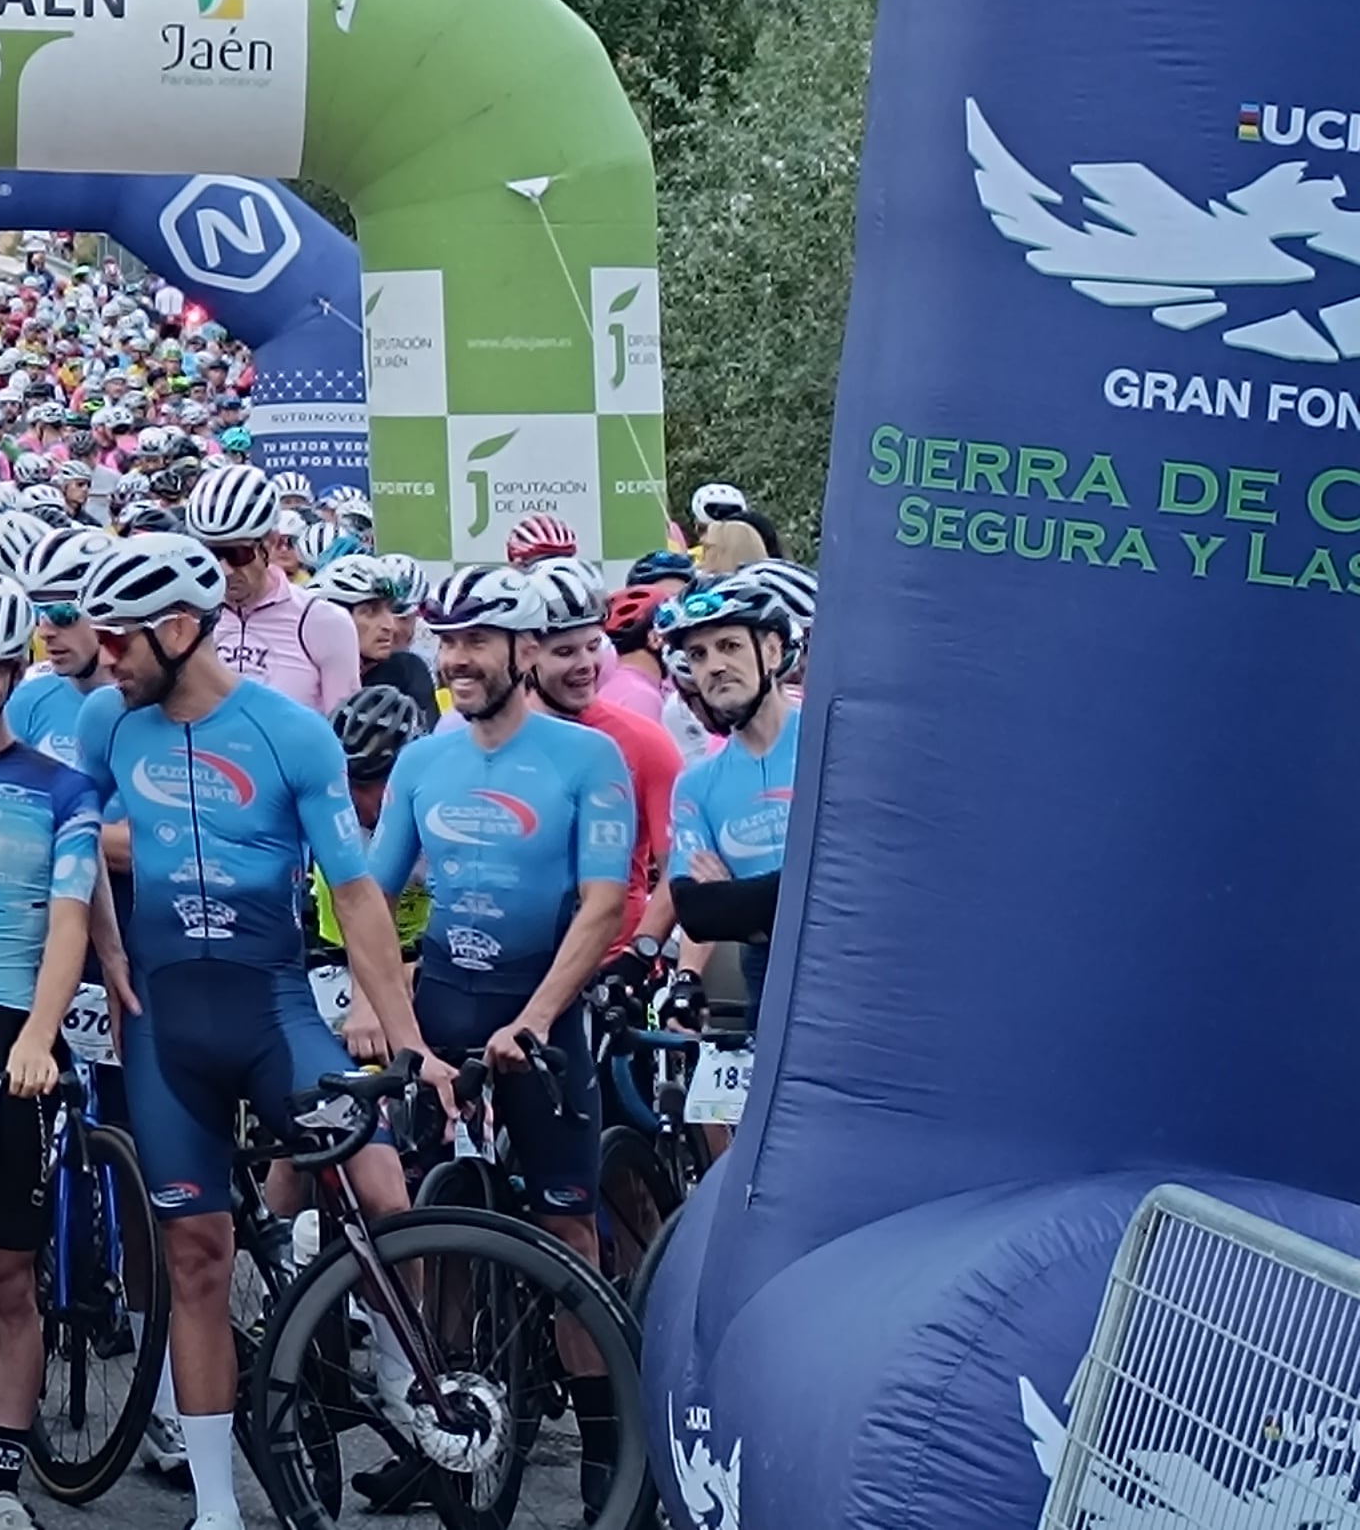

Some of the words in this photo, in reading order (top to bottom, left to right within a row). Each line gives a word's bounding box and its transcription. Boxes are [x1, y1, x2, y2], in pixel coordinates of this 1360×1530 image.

[160, 23, 273, 72] Jaén
[1262, 103, 1360, 153] UCI
[1103, 368, 1253, 420] GRAN
[494, 480, 588, 496] DIPUTACIÓN
[867, 424, 1131, 510] SIERRA
[1158, 460, 1281, 525] DE
[495, 500, 517, 513] DE
[896, 495, 1158, 572] SEGURA
[1179, 532, 1226, 579] Y
[146, 763, 226, 785] CAZORLA
[63, 1007, 112, 1037] 670
